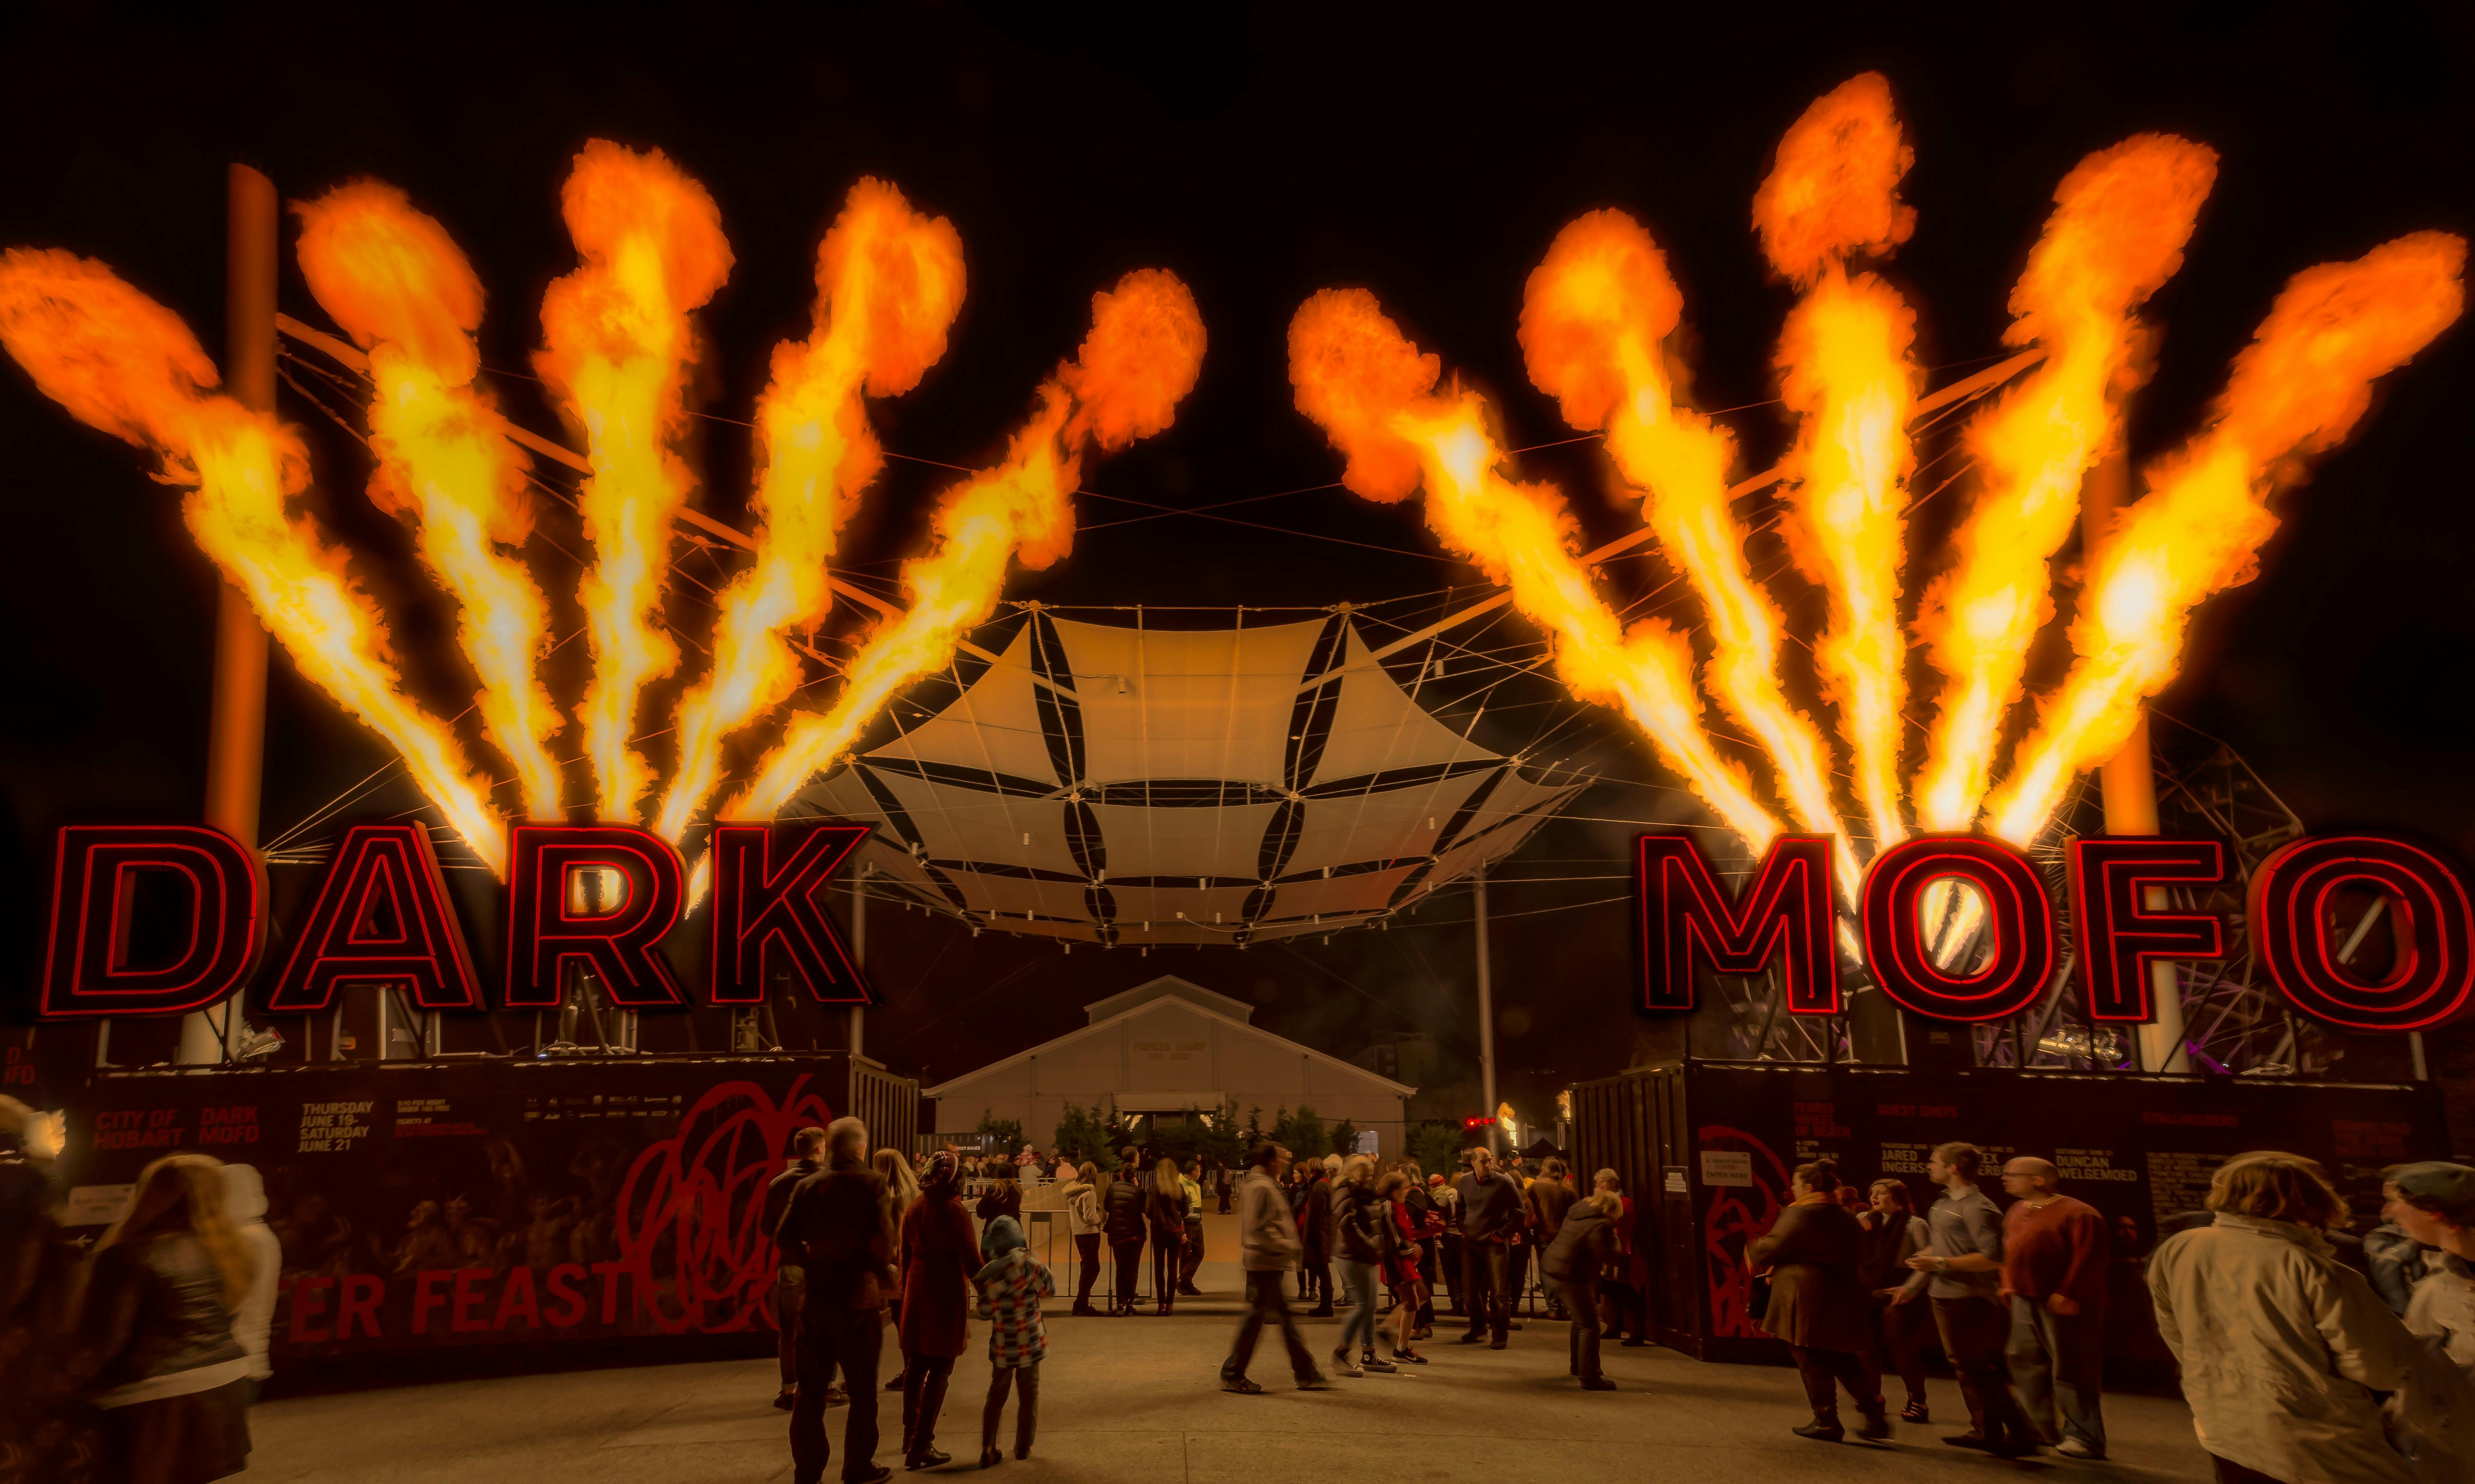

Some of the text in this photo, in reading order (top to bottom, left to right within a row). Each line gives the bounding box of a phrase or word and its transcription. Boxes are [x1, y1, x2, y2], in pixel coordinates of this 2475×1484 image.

[37, 821, 878, 1019] DARK
[1636, 833, 2475, 1032] MOFO
[200, 1104, 259, 1125] DARK
[302, 1101, 374, 1115] THURSDAY
[1877, 1104, 1916, 1117] GUEST
[96, 1108, 179, 1130] CITY OF
[300, 1114, 334, 1127] JUNE
[93, 1127, 186, 1151] HOBART
[198, 1124, 260, 1145] MOFO
[299, 1126, 370, 1140] SATURDAY
[297, 1139, 351, 1153] JUNE 21
[1882, 1149, 1918, 1161] JARED
[2055, 1155, 2109, 1168] DUNCAN
[412, 1261, 634, 1336] FEAST
